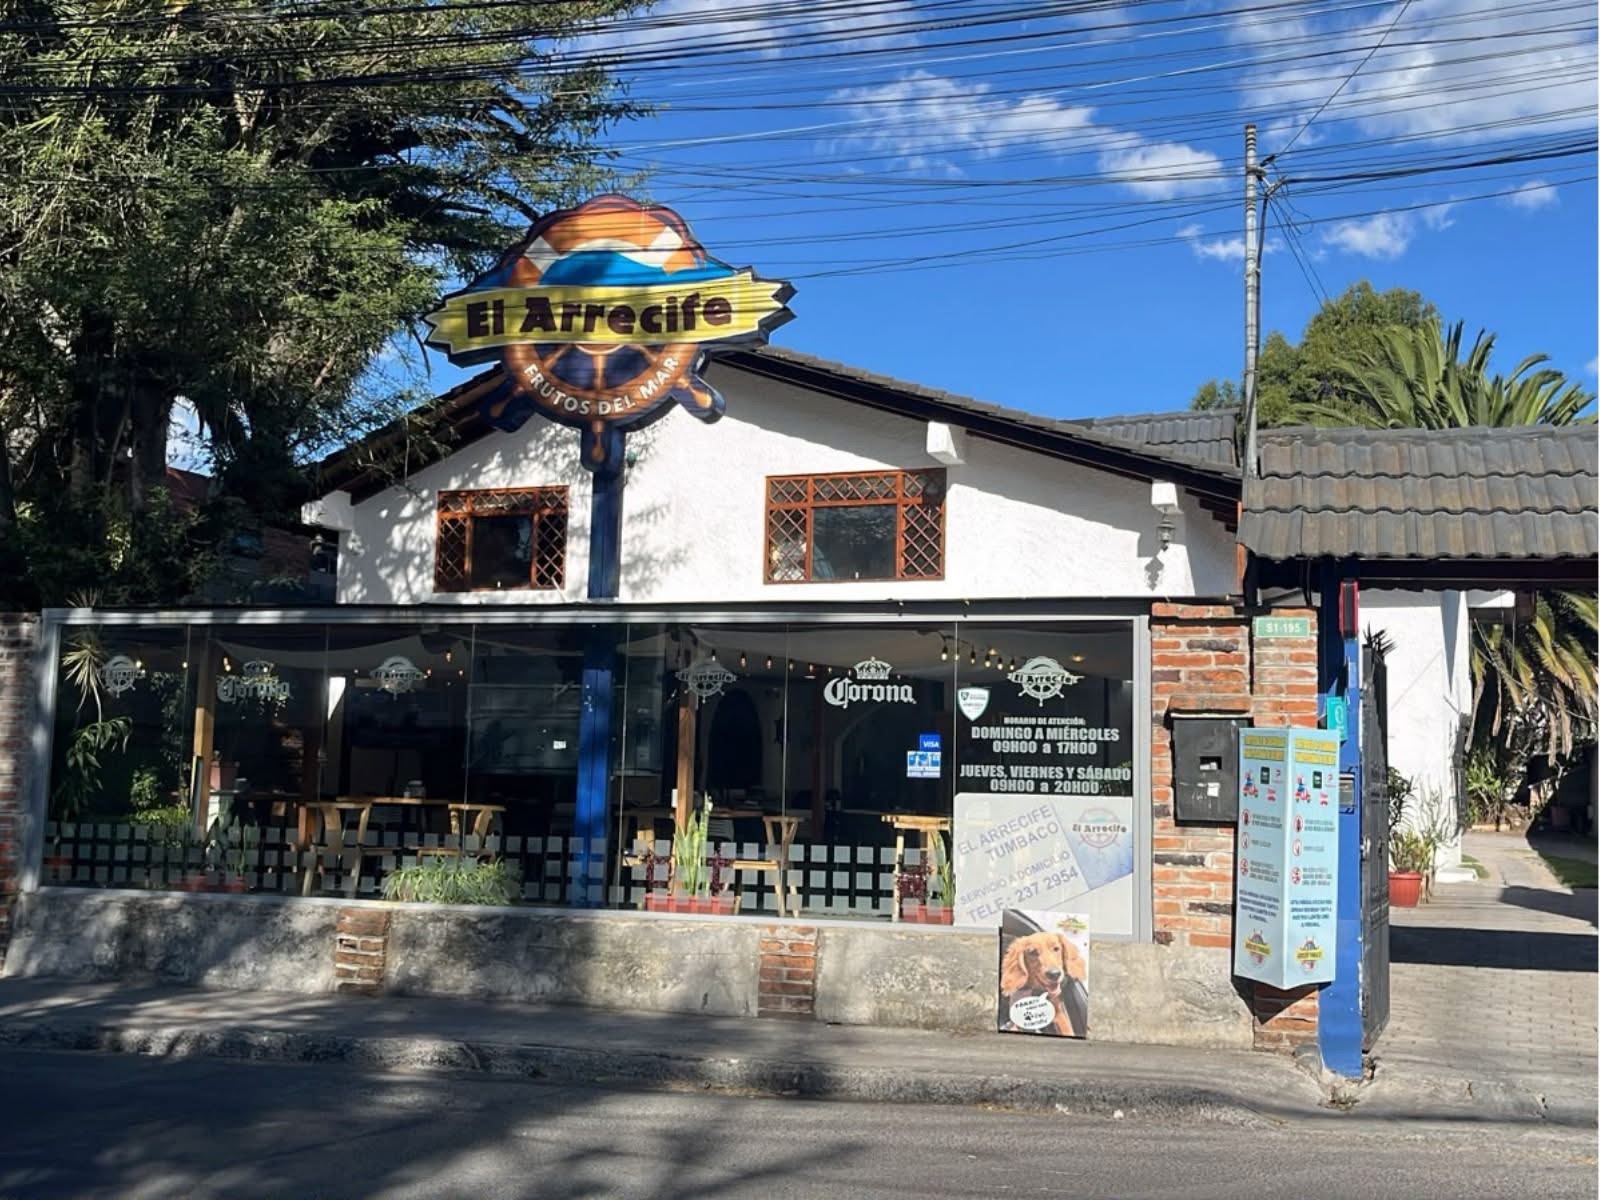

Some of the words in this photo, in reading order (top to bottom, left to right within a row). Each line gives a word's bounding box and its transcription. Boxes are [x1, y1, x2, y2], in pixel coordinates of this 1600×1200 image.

[467, 300, 504, 338] El
[519, 292, 733, 335] Arrecife
[523, 363, 592, 415] FRUTOS
[598, 393, 637, 415] DEL
[638, 357, 680, 399] MAR
[823, 677, 912, 709] Corona
[923, 741, 939, 749] VISA
[971, 726, 1032, 740] DOMINGO
[1034, 728, 1045, 740] A
[1046, 725, 1120, 742] MIÉRCOLES
[992, 741, 1037, 754] 09H00
[1042, 744, 1052, 754] a
[1056, 742, 1097, 755] 17H00
[960, 765, 1008, 779] JUEVES,
[1010, 766, 1064, 780] VIERNES
[1066, 768, 1076, 780] Y
[1078, 765, 1131, 781] SÁBADO
[990, 780, 1035, 792] 09H00
[1040, 782, 1049, 793] a
[1054, 781, 1099, 794] 20H00
[958, 840, 978, 855] EL
[979, 804, 1052, 847] ARRECIFE
[984, 821, 1060, 861] TUMBACO
[960, 878, 1007, 905] SERVICIO
[1015, 882, 1039, 903] 237
[1043, 865, 1079, 891] 2954
